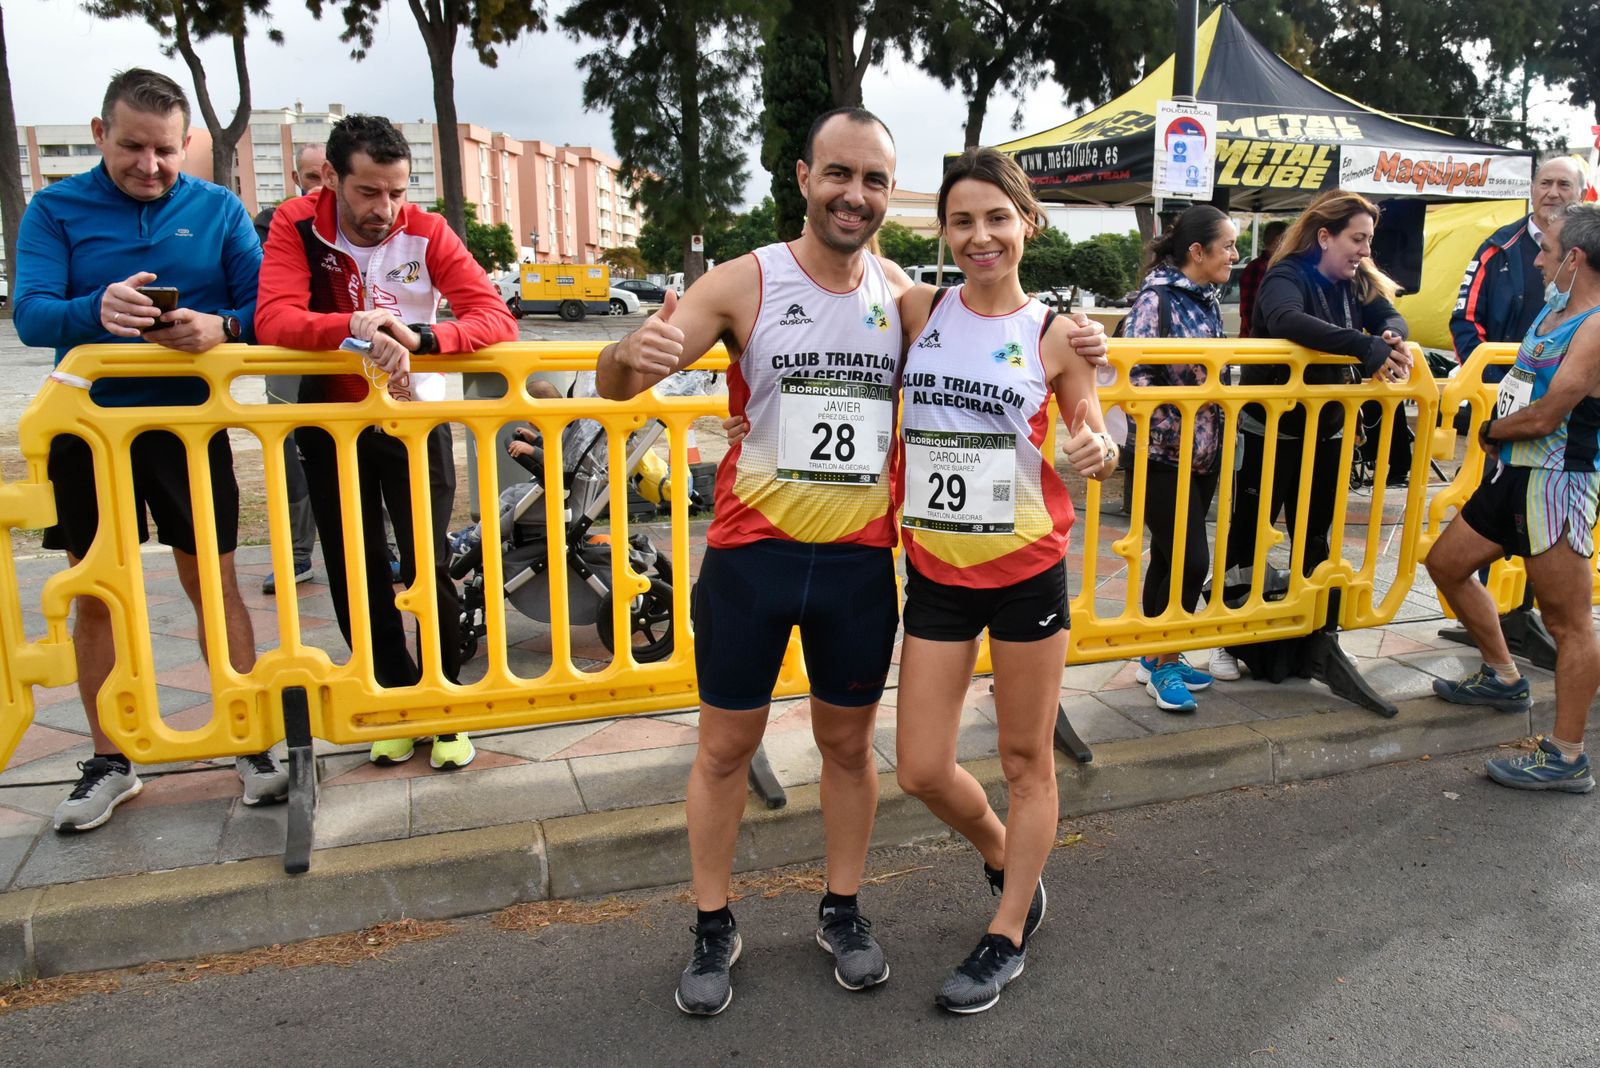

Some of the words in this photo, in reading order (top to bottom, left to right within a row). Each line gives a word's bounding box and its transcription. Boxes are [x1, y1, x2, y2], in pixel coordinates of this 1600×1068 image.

[1021, 142, 1118, 172] www.metallube.es
[1215, 139, 1332, 167] METAL
[1342, 156, 1352, 169] En
[1097, 170, 1131, 181] TEAM
[1217, 163, 1328, 189] LUBE
[1341, 164, 1375, 184] Palmones
[1373, 151, 1491, 193] Maquipal
[772, 352, 820, 369] CLUB
[825, 352, 896, 373] TRIATLÓN
[789, 384, 848, 396] BORRIQUÍN
[902, 373, 936, 388] CLUB
[942, 375, 1025, 409] TRIATLÓN
[824, 401, 861, 413] JAVIER
[913, 391, 1005, 416] ALGECIRAS
[1499, 388, 1515, 416] 167
[839, 413, 849, 421] DEL
[810, 422, 855, 462] 28
[911, 436, 958, 447] BORRIQUÍN
[838, 463, 870, 471] ALGECIRAS
[929, 450, 981, 464] CAROLINA
[928, 472, 966, 511] 29
[951, 512, 983, 521] ALGECIRAS
